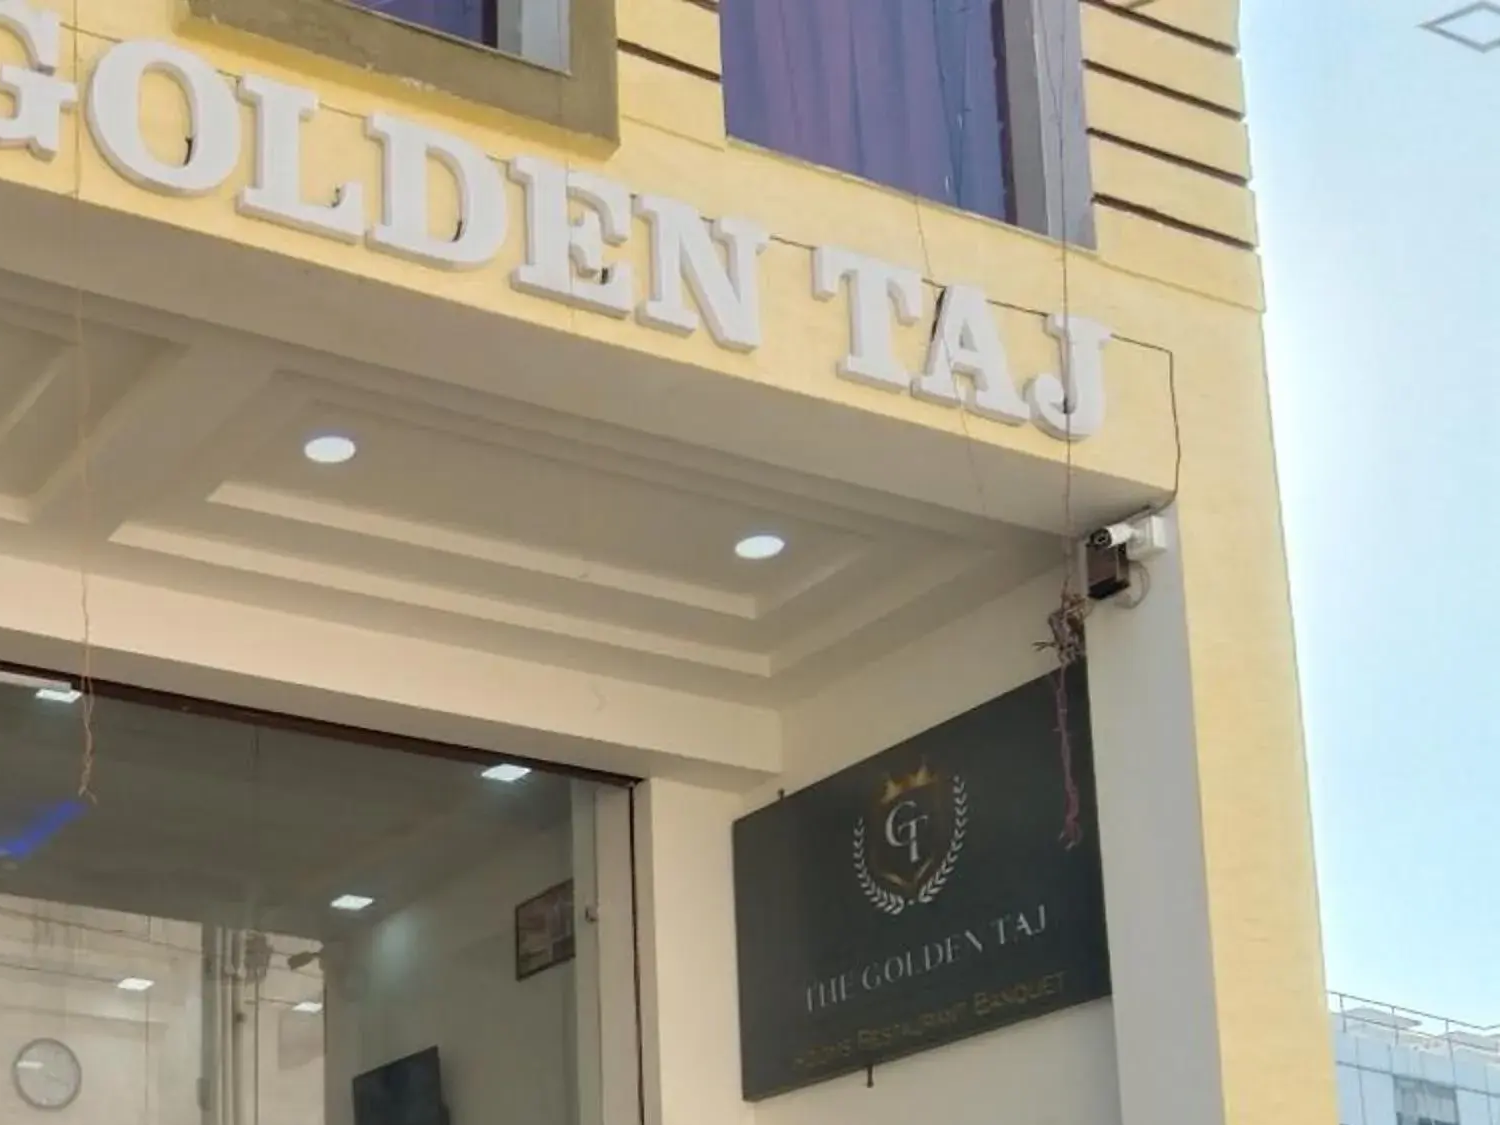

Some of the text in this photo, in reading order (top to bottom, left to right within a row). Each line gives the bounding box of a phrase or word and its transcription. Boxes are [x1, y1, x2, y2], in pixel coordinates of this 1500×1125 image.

[812, 246, 1111, 442] TAJ
[804, 904, 1047, 1013] THE GOLDEN TAJ
